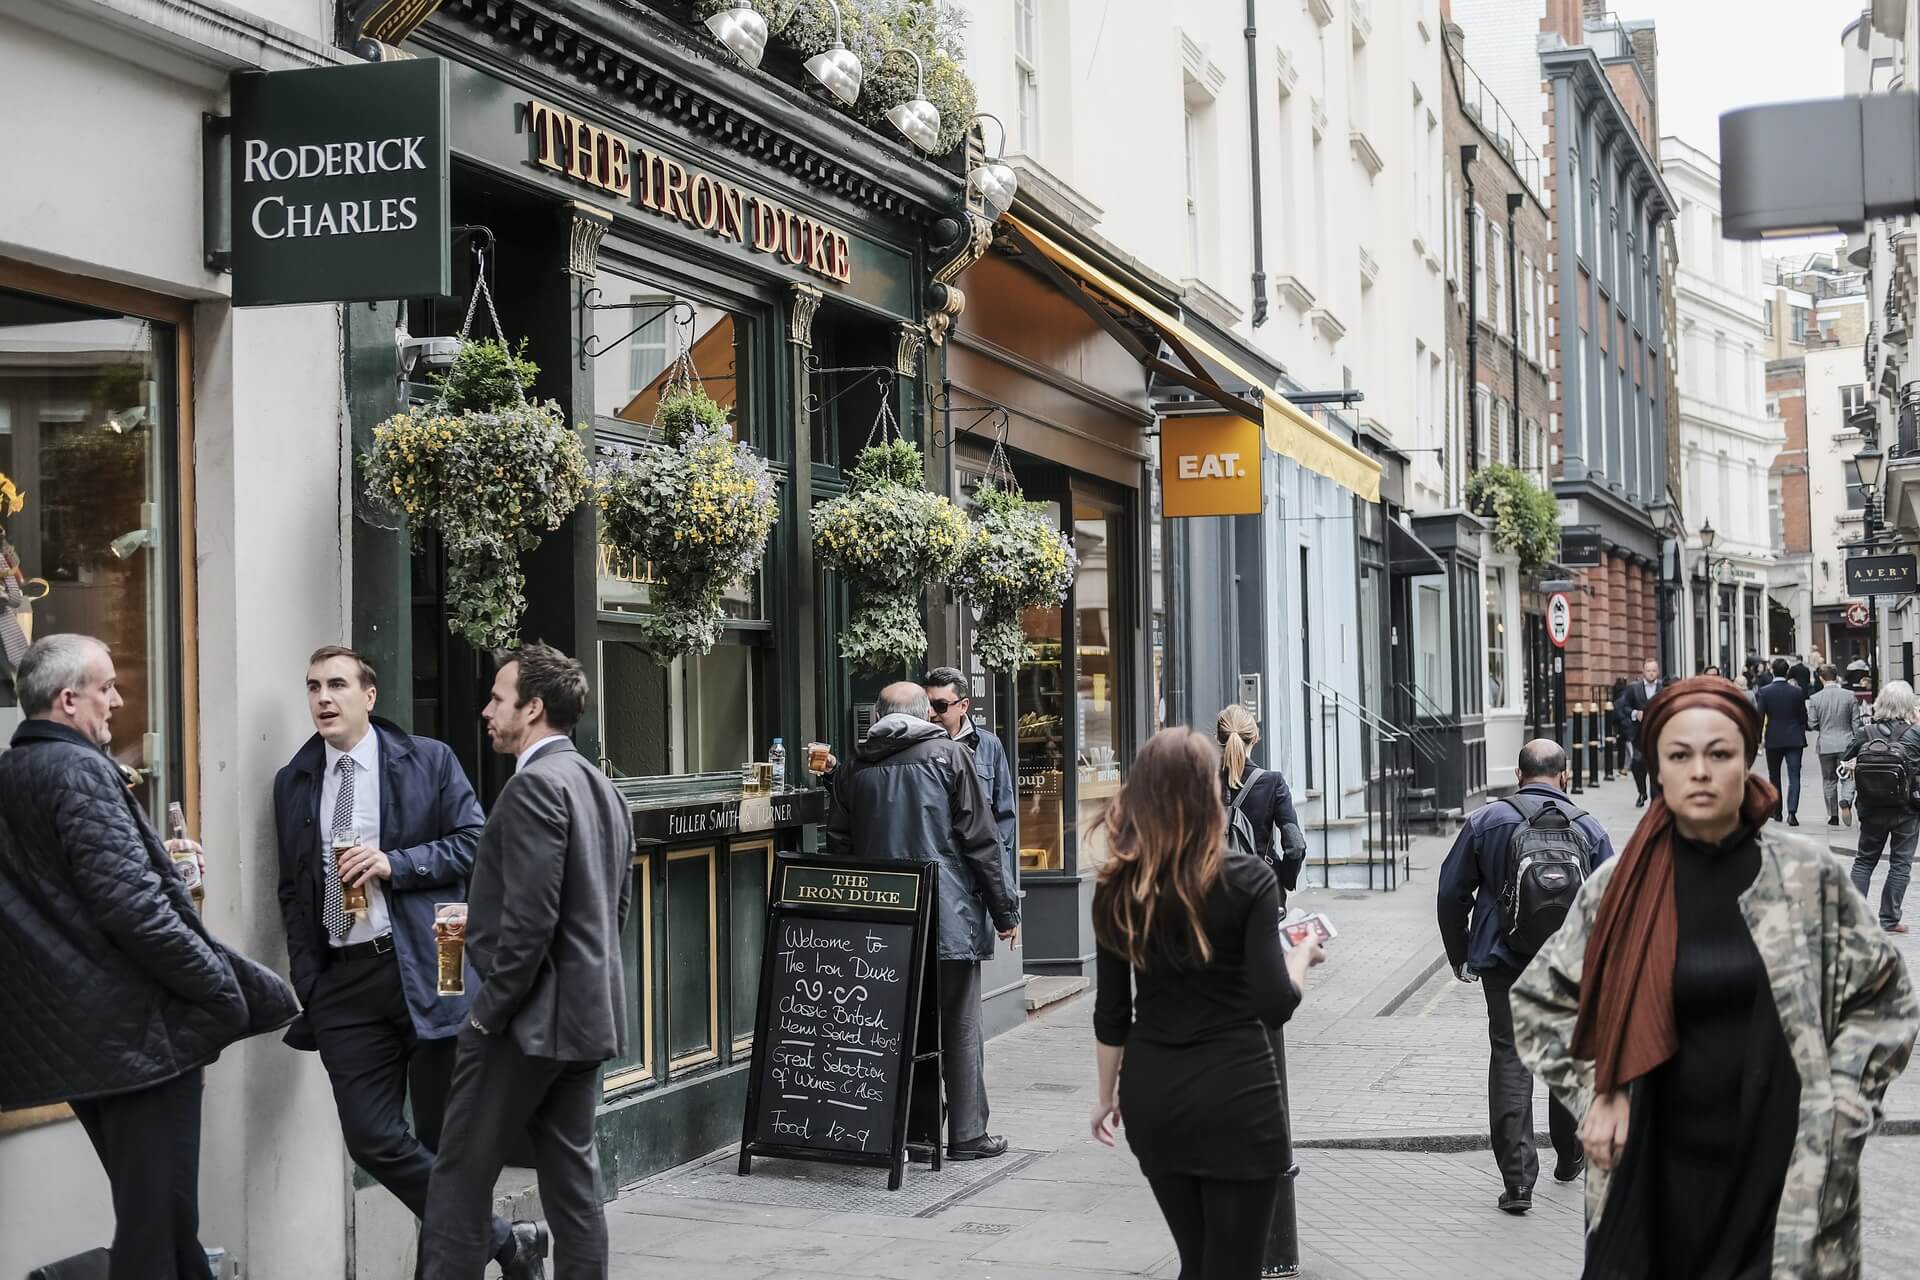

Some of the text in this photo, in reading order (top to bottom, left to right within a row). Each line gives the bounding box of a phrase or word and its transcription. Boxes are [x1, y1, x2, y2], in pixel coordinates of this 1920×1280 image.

[243, 136, 427, 182] RODERICK
[528, 100, 851, 284] THE IRON DUKE
[251, 196, 418, 239] CHARLES
[1178, 453, 1246, 479] EAT.
[1854, 567, 1909, 578] AVERY
[668, 814, 707, 836] FULLER
[708, 809, 741, 831] SMITH
[755, 804, 792, 825] TURNER
[798, 886, 900, 904] IRON DUKE
[832, 874, 869, 888] THE
[785, 925, 889, 954] Welcome to
[778, 949, 900, 983] The Iron Duke
[779, 995, 889, 1030] Classic British
[779, 1016, 818, 1037] Menu
[821, 1023, 865, 1046] Served
[772, 1046, 888, 1084] Great Selection
[794, 1071, 837, 1092] Wines
[854, 1082, 883, 1102] Ales
[770, 1109, 871, 1152] Food 12-9
